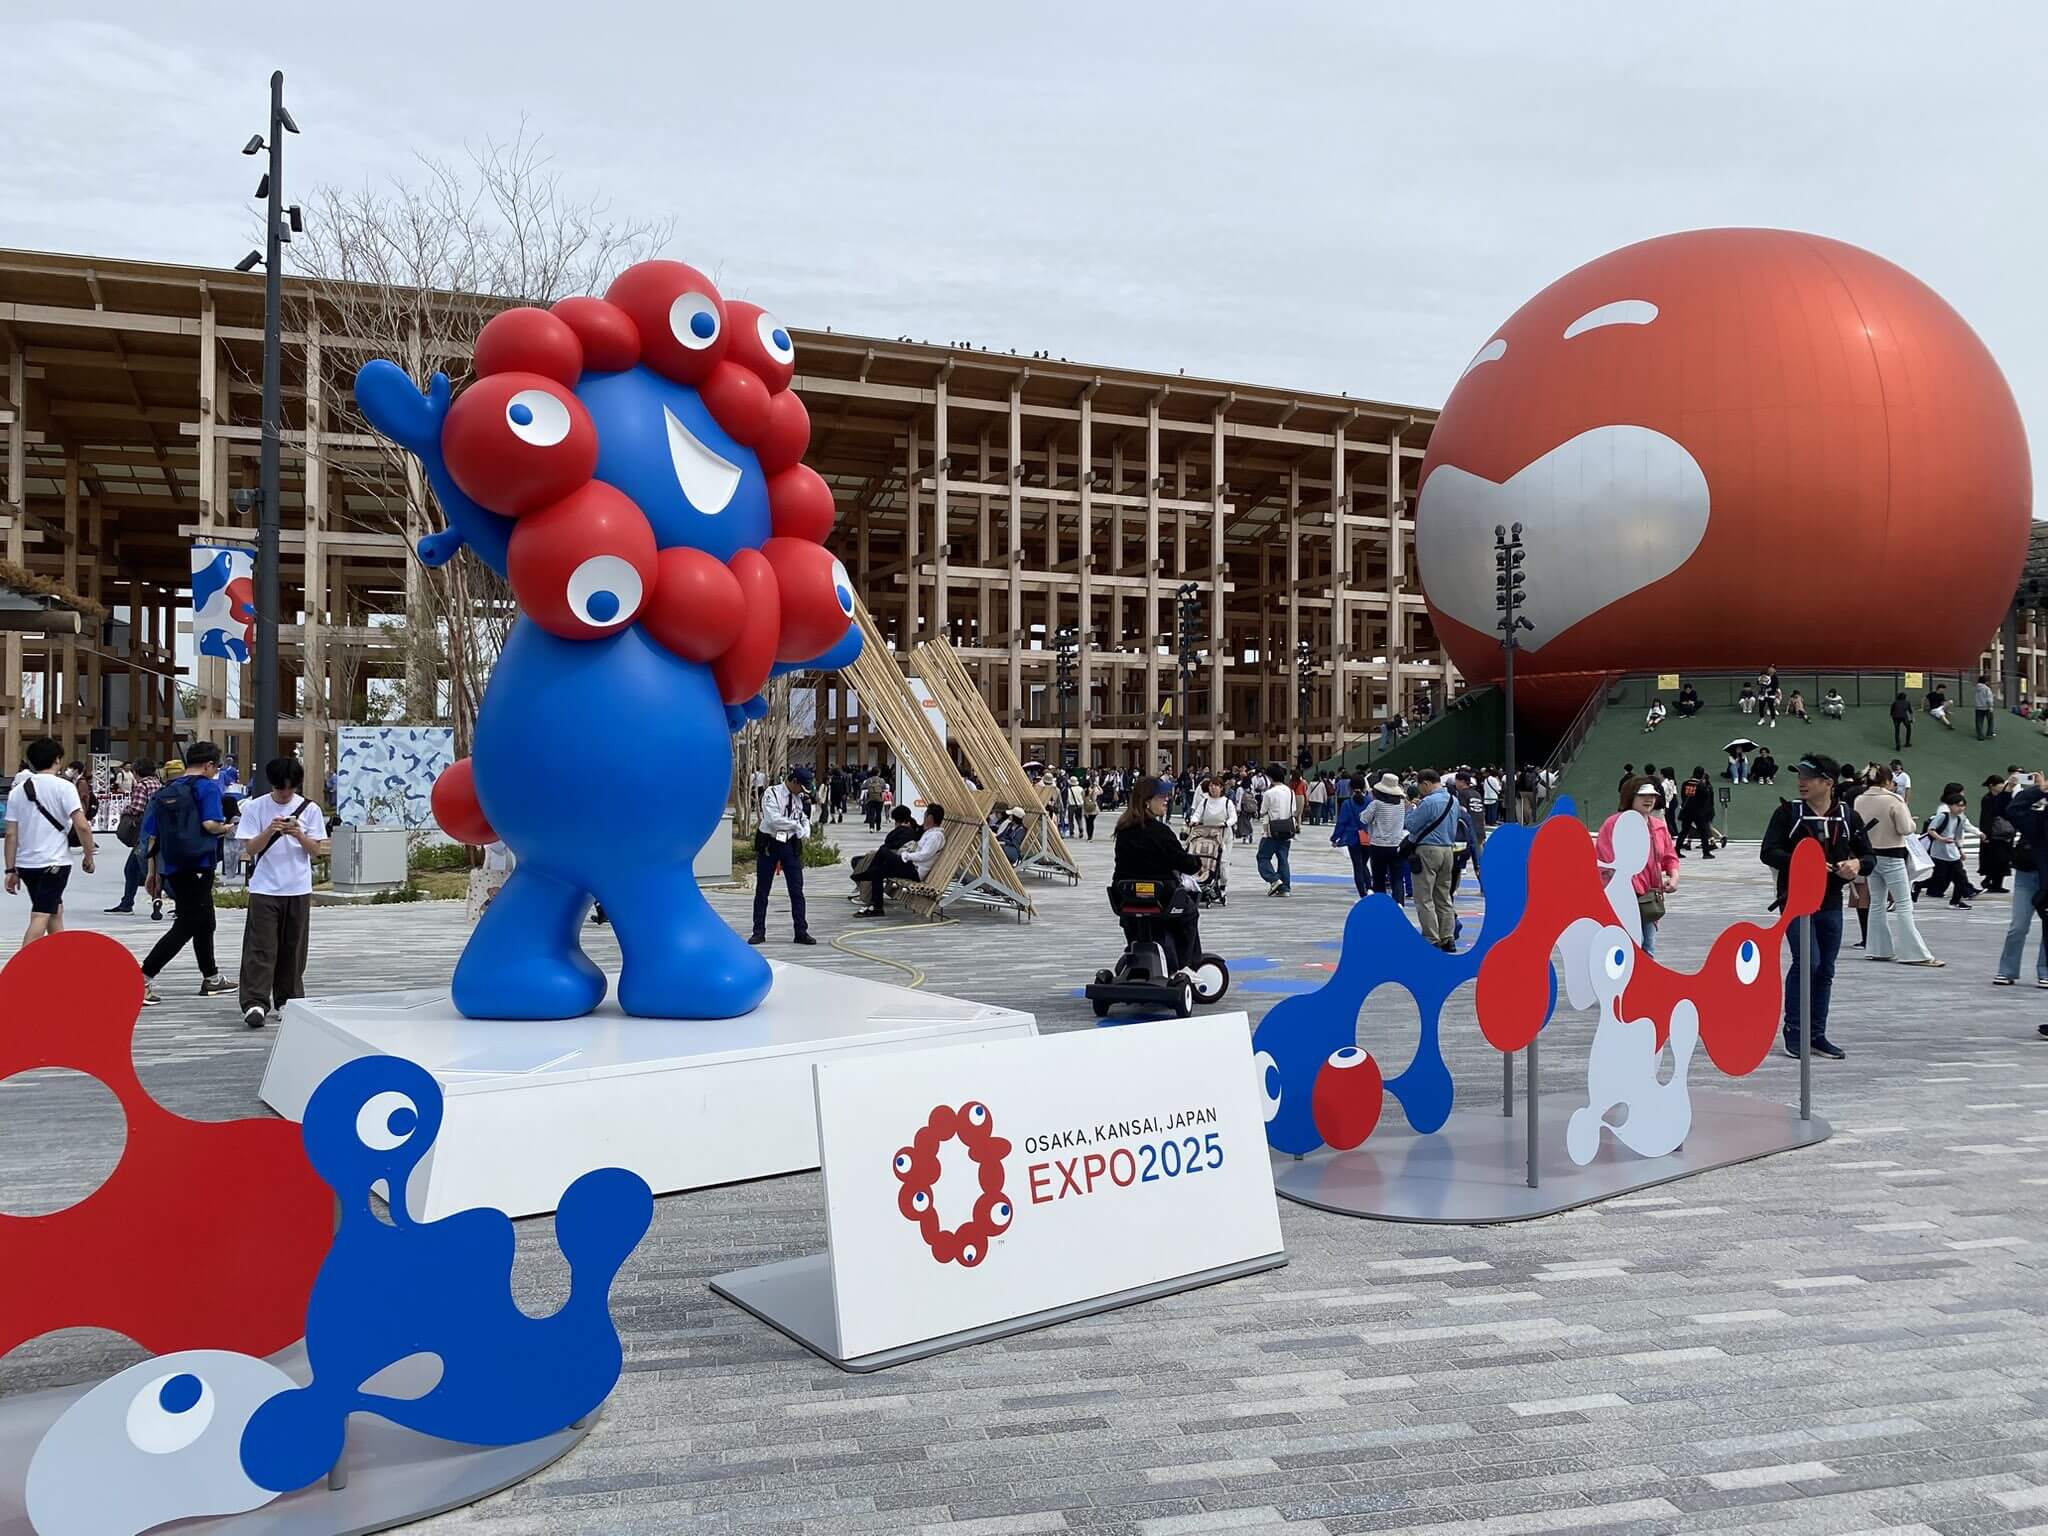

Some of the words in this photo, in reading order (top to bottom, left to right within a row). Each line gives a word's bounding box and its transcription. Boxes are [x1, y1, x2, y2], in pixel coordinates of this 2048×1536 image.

[1025, 1129, 1092, 1153] OSAKA,
[1095, 1117, 1163, 1142] KANSAI,
[1167, 1107, 1217, 1130] JAPAN
[1028, 1133, 1224, 1205] EXPO2025
